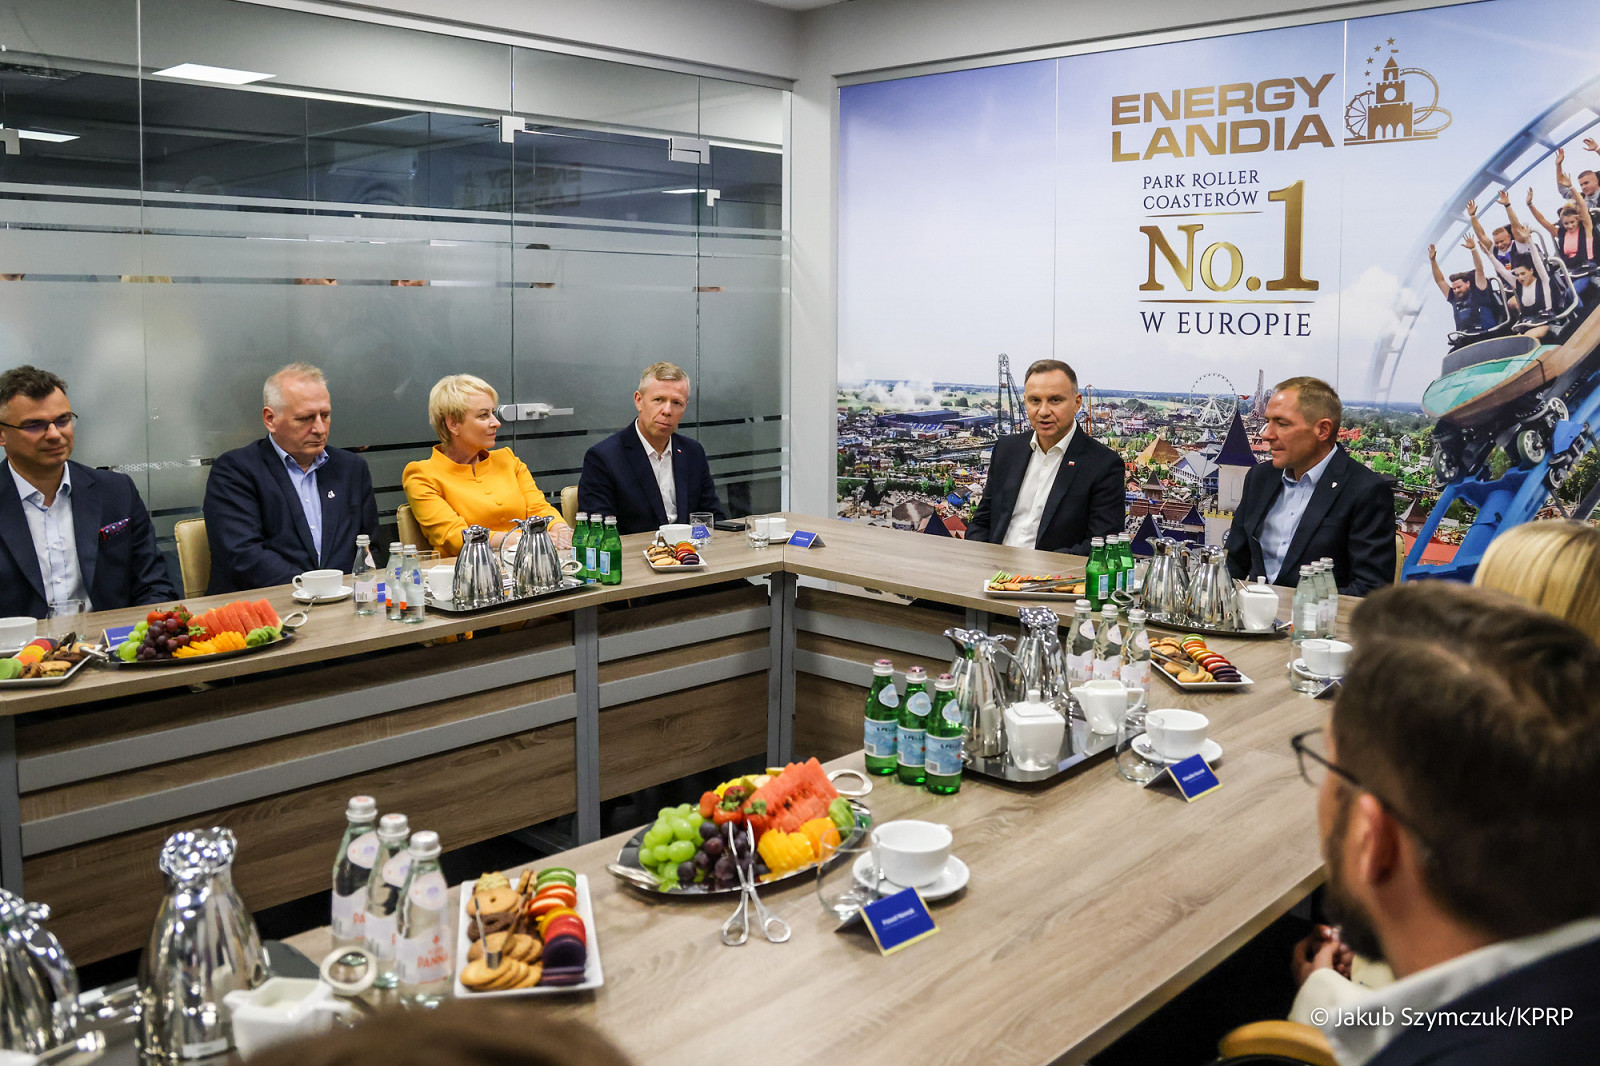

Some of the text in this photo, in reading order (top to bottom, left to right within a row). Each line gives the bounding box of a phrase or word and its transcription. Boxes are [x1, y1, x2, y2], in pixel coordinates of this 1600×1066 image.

[1111, 73, 1336, 126] ENERGY
[1111, 114, 1336, 163] LANDIA
[1142, 169, 1261, 190] PARK ROLLER
[1142, 188, 1260, 211] COASTERÓW
[1139, 311, 1313, 337] W EUROPIE
